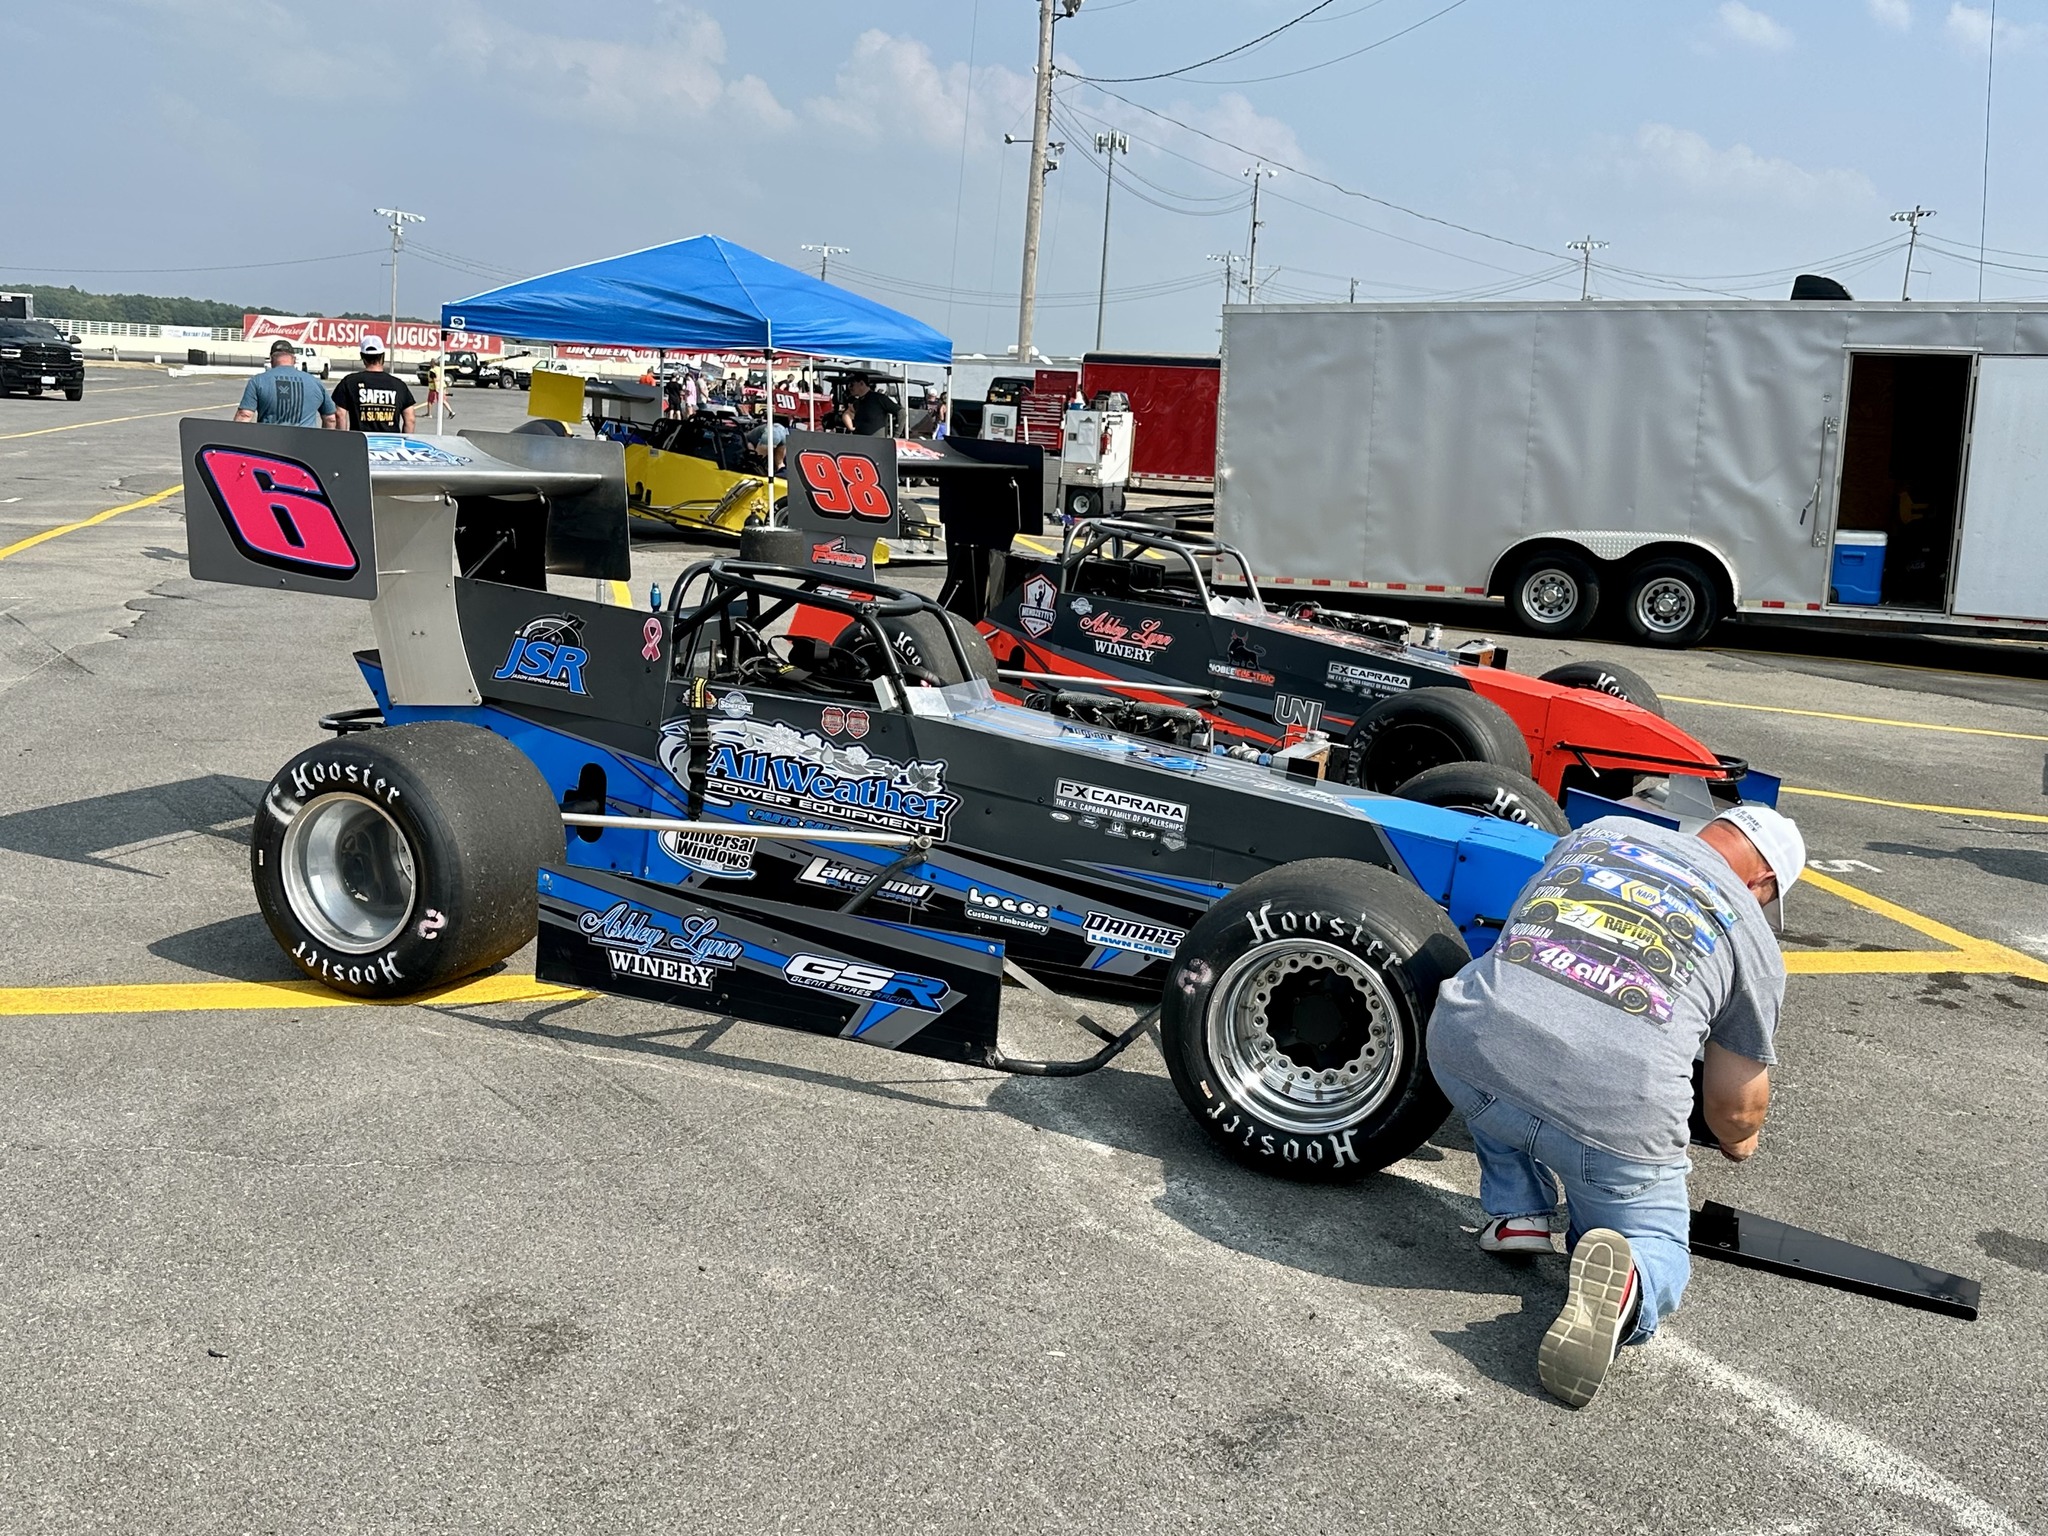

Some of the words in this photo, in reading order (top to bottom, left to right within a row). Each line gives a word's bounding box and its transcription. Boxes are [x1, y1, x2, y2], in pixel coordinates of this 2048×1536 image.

[258, 321, 306, 336] Budweiser
[309, 321, 370, 343] CLASSIC
[450, 333, 490, 350] 29-31
[358, 389, 397, 405] SAFETY
[776, 393, 797, 410] 90
[366, 411, 395, 422] SLOGAN
[799, 452, 892, 519] 98
[199, 447, 359, 573] 6
[1079, 611, 1129, 643] Ashley
[1131, 619, 1175, 649] Lynn
[494, 637, 588, 695] JSR
[1094, 639, 1156, 664] WINERY
[550, 680, 570, 688] RACING
[1330, 663, 1349, 675] FX
[1350, 667, 1409, 687] CAPRARA
[1275, 694, 1323, 730] UNI
[290, 761, 400, 805] Hoosier
[706, 746, 768, 787] All
[770, 757, 950, 822] Weather
[1060, 782, 1089, 799] FX
[1091, 789, 1184, 819] CAPRARA
[706, 780, 793, 807] POWER
[798, 798, 938, 835] EQUIPMENT
[752, 809, 799, 828] PARTS
[1055, 797, 1067, 806] THE
[1079, 803, 1109, 816] CAPRARA
[1108, 808, 1132, 820] FAMILY
[1132, 814, 1142, 822] OF
[1141, 816, 1184, 832] DEALERSHIPS
[678, 832, 758, 854] Universal
[1582, 827, 1628, 842] LARSON
[676, 840, 750, 869] Windows
[1559, 853, 1596, 865] ELLIOTT
[800, 856, 930, 898] Lakelnd
[1587, 869, 1626, 890] 9
[967, 886, 1050, 920] LOGOS
[1635, 888, 1658, 902] NAPA
[579, 902, 665, 956] Ashley
[670, 915, 743, 965] Lynn
[966, 908, 998, 922] Custom
[999, 914, 1049, 933] Embroidery
[1085, 912, 1184, 947] DANA'S
[1245, 901, 1403, 971] Hoosier
[1561, 905, 1603, 928] 24
[1603, 915, 1659, 946] RAPTOR
[1090, 934, 1133, 948] LAWN
[1134, 942, 1172, 956] CARE
[291, 941, 406, 985] Hoosier
[609, 949, 714, 987] WINERY
[1537, 947, 1577, 970] 48
[1575, 962, 1627, 995] ally
[784, 954, 946, 1009] GSR
[790, 974, 826, 988] GLENN
[827, 981, 873, 998] STYRES
[871, 991, 916, 1006] RACING
[1206, 1101, 1361, 1169] Hoosier
